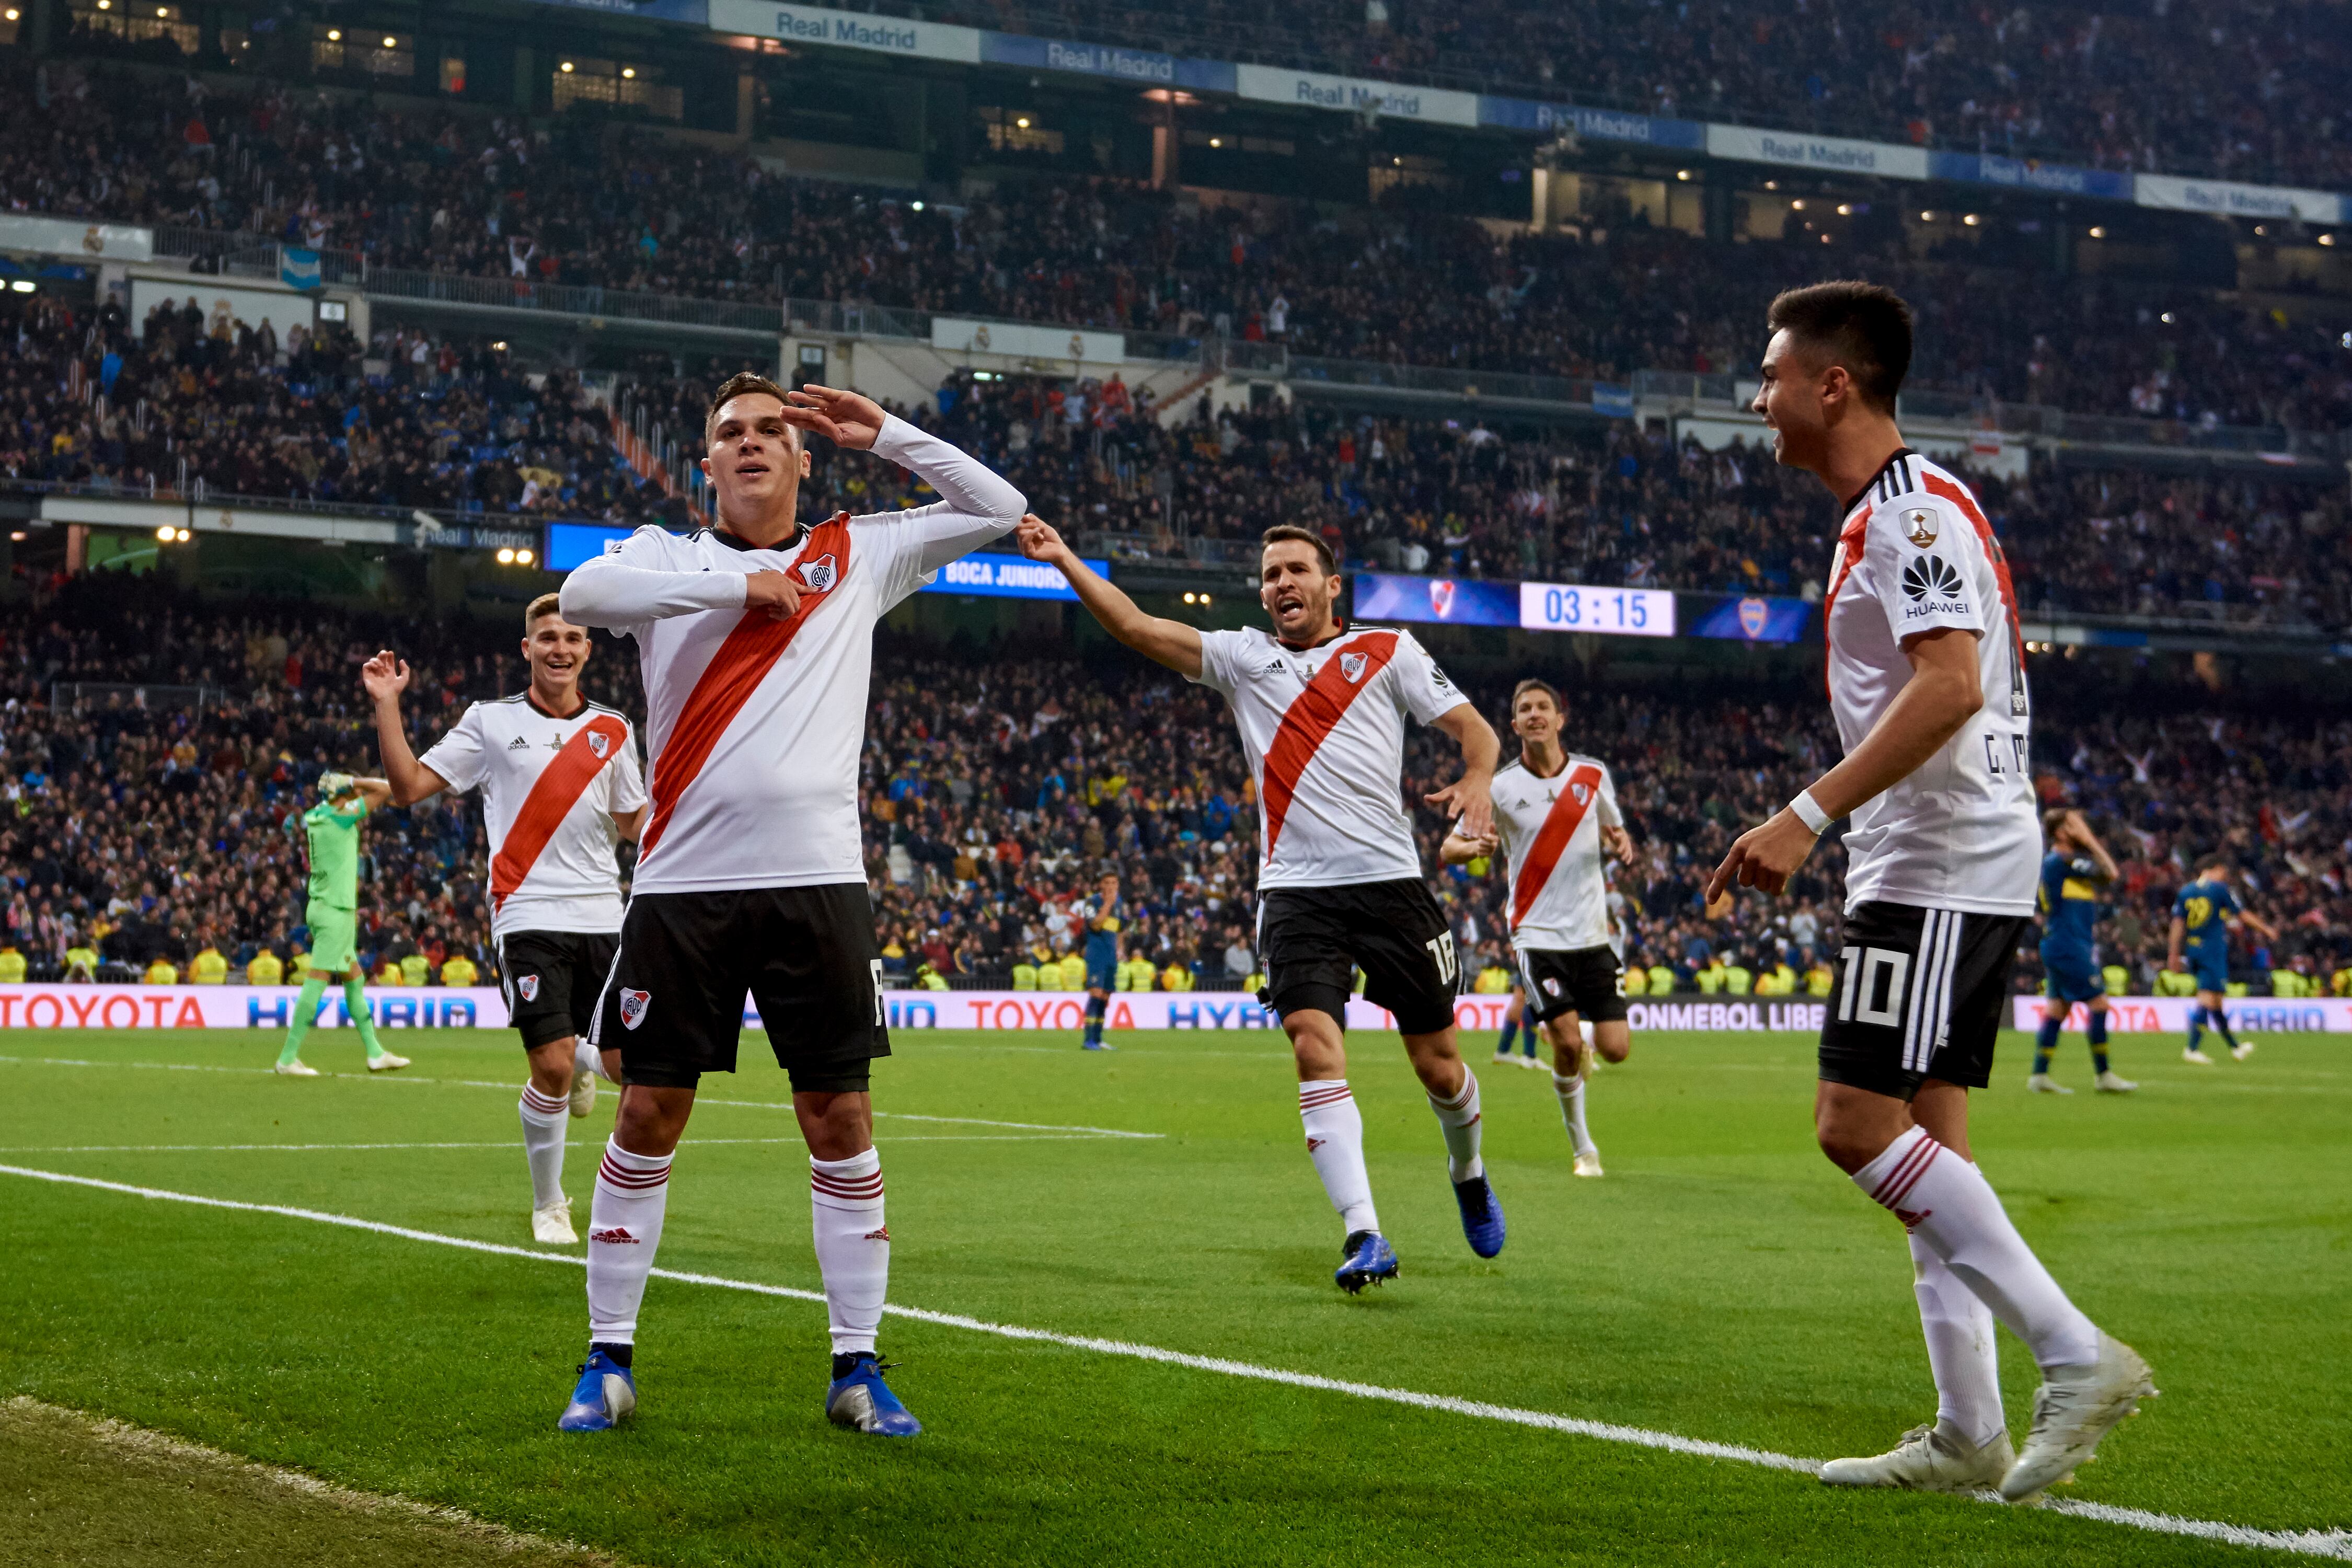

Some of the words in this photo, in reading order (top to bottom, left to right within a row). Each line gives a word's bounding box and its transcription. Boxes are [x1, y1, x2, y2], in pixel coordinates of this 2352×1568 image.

[777, 11, 829, 37] Real
[836, 18, 916, 49] Madrid
[1048, 43, 1094, 68] Real
[1100, 50, 1172, 80] Madrid
[1297, 80, 1343, 105] Real
[1762, 137, 1805, 158] Real
[473, 528, 534, 547] Madrid
[946, 560, 993, 585] BOCA
[996, 563, 1068, 591] JUNIORS
[1545, 589, 1581, 624] 03
[1613, 593, 1647, 628] 15
[1906, 602, 1969, 619] HUAWEI
[1838, 946, 1910, 1028] 10
[0, 994, 206, 1029] TOYOTA
[1627, 1002, 1765, 1031] ONMEBOL
[1769, 1002, 1827, 1031] LIBE
[591, 1235, 640, 1244] adidas
